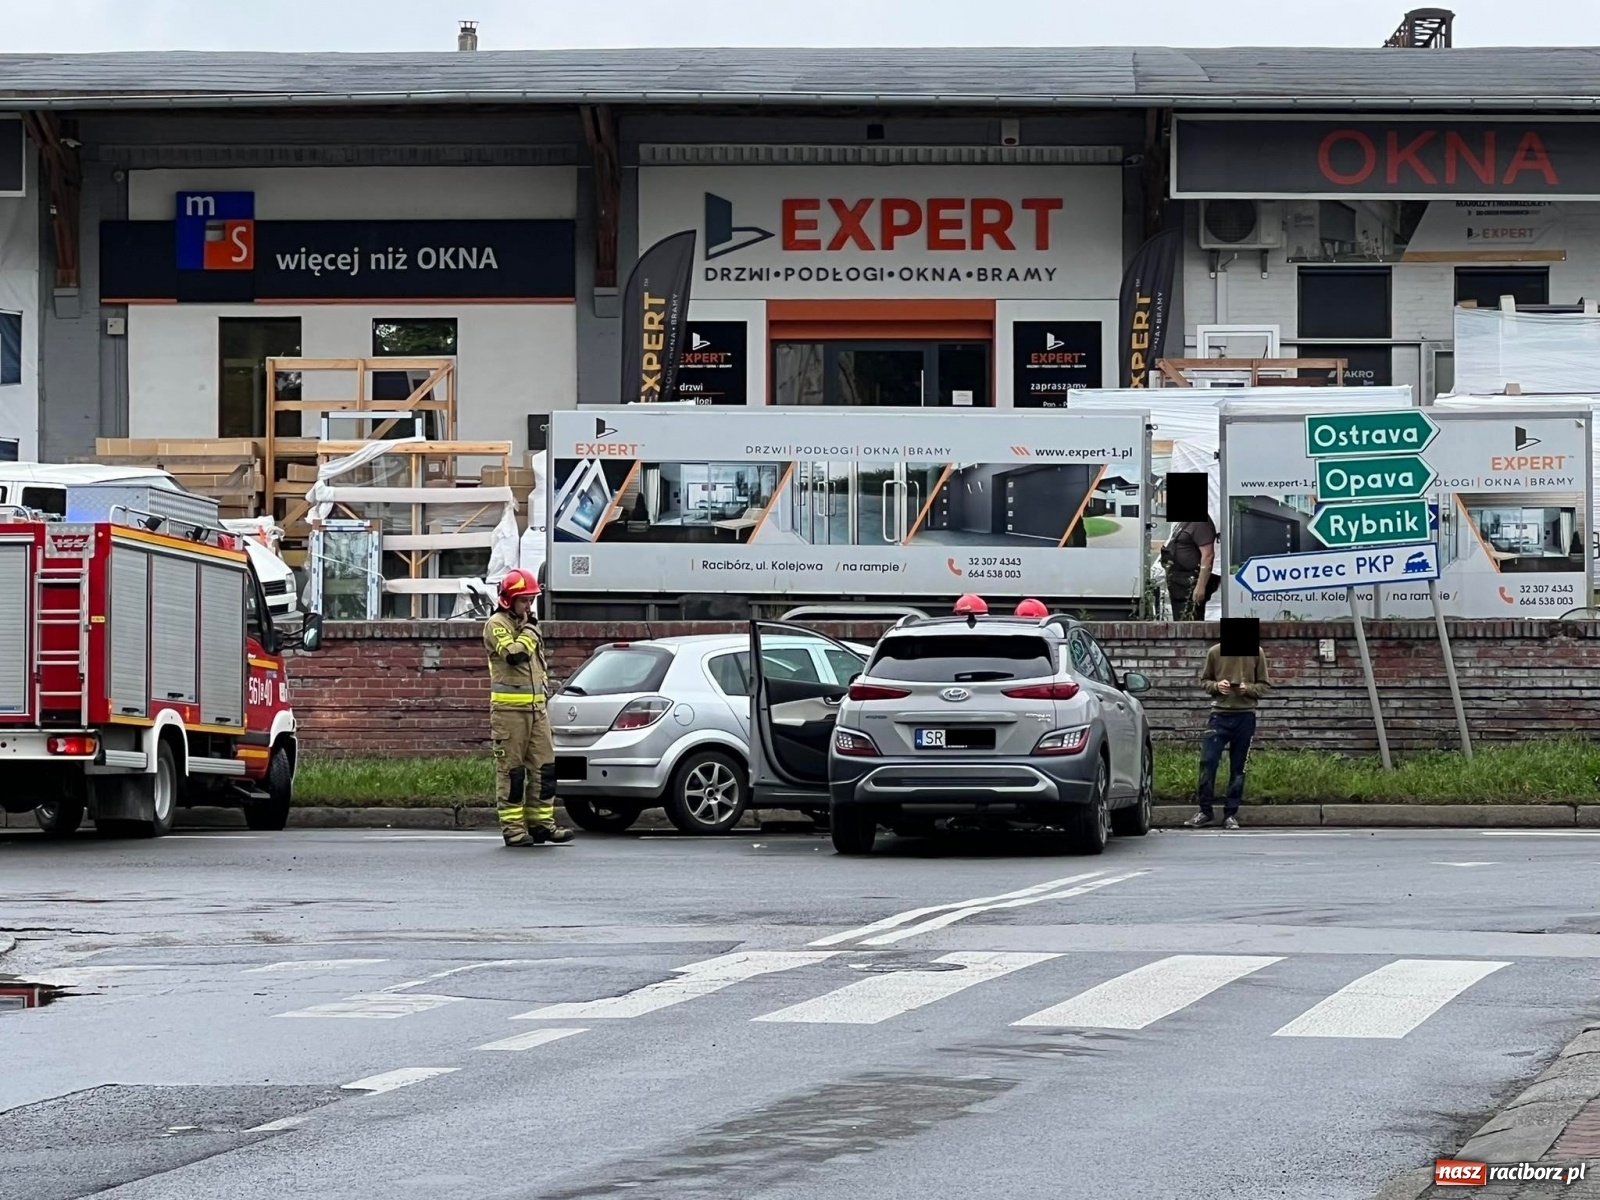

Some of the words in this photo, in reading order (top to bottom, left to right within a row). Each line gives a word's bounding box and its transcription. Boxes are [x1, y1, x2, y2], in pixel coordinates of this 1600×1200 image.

[1317, 128, 1560, 186] OKNA
[781, 198, 1064, 252] EXPERT
[1482, 228, 1535, 239] EXPERT
[275, 246, 360, 277] więcej
[370, 246, 408, 270] niż
[417, 247, 499, 271] OKNA
[705, 266, 771, 283] DRZWI
[899, 266, 961, 282] OKNA
[978, 266, 1058, 283] BRAMY
[670, 293, 678, 325] BRAMY
[1130, 291, 1152, 388] XPERT
[1031, 352, 1079, 363] EXPERT
[1342, 370, 1374, 378] AKRO
[679, 383, 703, 391] drzwi
[1030, 383, 1087, 392] zapraszamy
[1314, 424, 1419, 447] Ostrava
[575, 443, 638, 456] EXPERT
[745, 445, 787, 454] DRZWI
[796, 446, 854, 455] PODŁOGI
[863, 446, 900, 456] OKNA
[908, 447, 952, 456] BRAMY
[1035, 446, 1133, 459] www.expert-1.pl
[1491, 456, 1566, 471] EXPERT
[1241, 479, 1317, 489] www.expert-1.p
[1325, 468, 1414, 496] Opava
[1435, 478, 1475, 487] DŁOGI
[1484, 478, 1521, 487] OKNA
[1530, 477, 1574, 487] BRAMY
[1329, 510, 1419, 543] Rybnik
[702, 559, 754, 572] Racibórz,
[756, 560, 769, 571] ul.
[771, 560, 824, 573] Kolejowa
[859, 561, 900, 574] rampie
[968, 557, 980, 567] 32
[981, 557, 998, 567] 307
[999, 557, 1022, 567] 4343
[1256, 563, 1346, 583] Dworzec
[1356, 554, 1394, 575] PKP
[968, 569, 984, 579] 664
[986, 569, 1003, 579] 538
[1004, 569, 1022, 579] 003
[1519, 584, 1532, 594] 32
[1533, 584, 1549, 593] 307
[1551, 584, 1574, 593] 4343
[1305, 592, 1319, 602] ul.
[1321, 591, 1374, 603] Kolejwa
[1410, 591, 1450, 601] ramie
[1519, 596, 1537, 606] 664
[1539, 596, 1555, 606] 538
[1556, 596, 1574, 606] 003
[925, 730, 943, 745] SR
